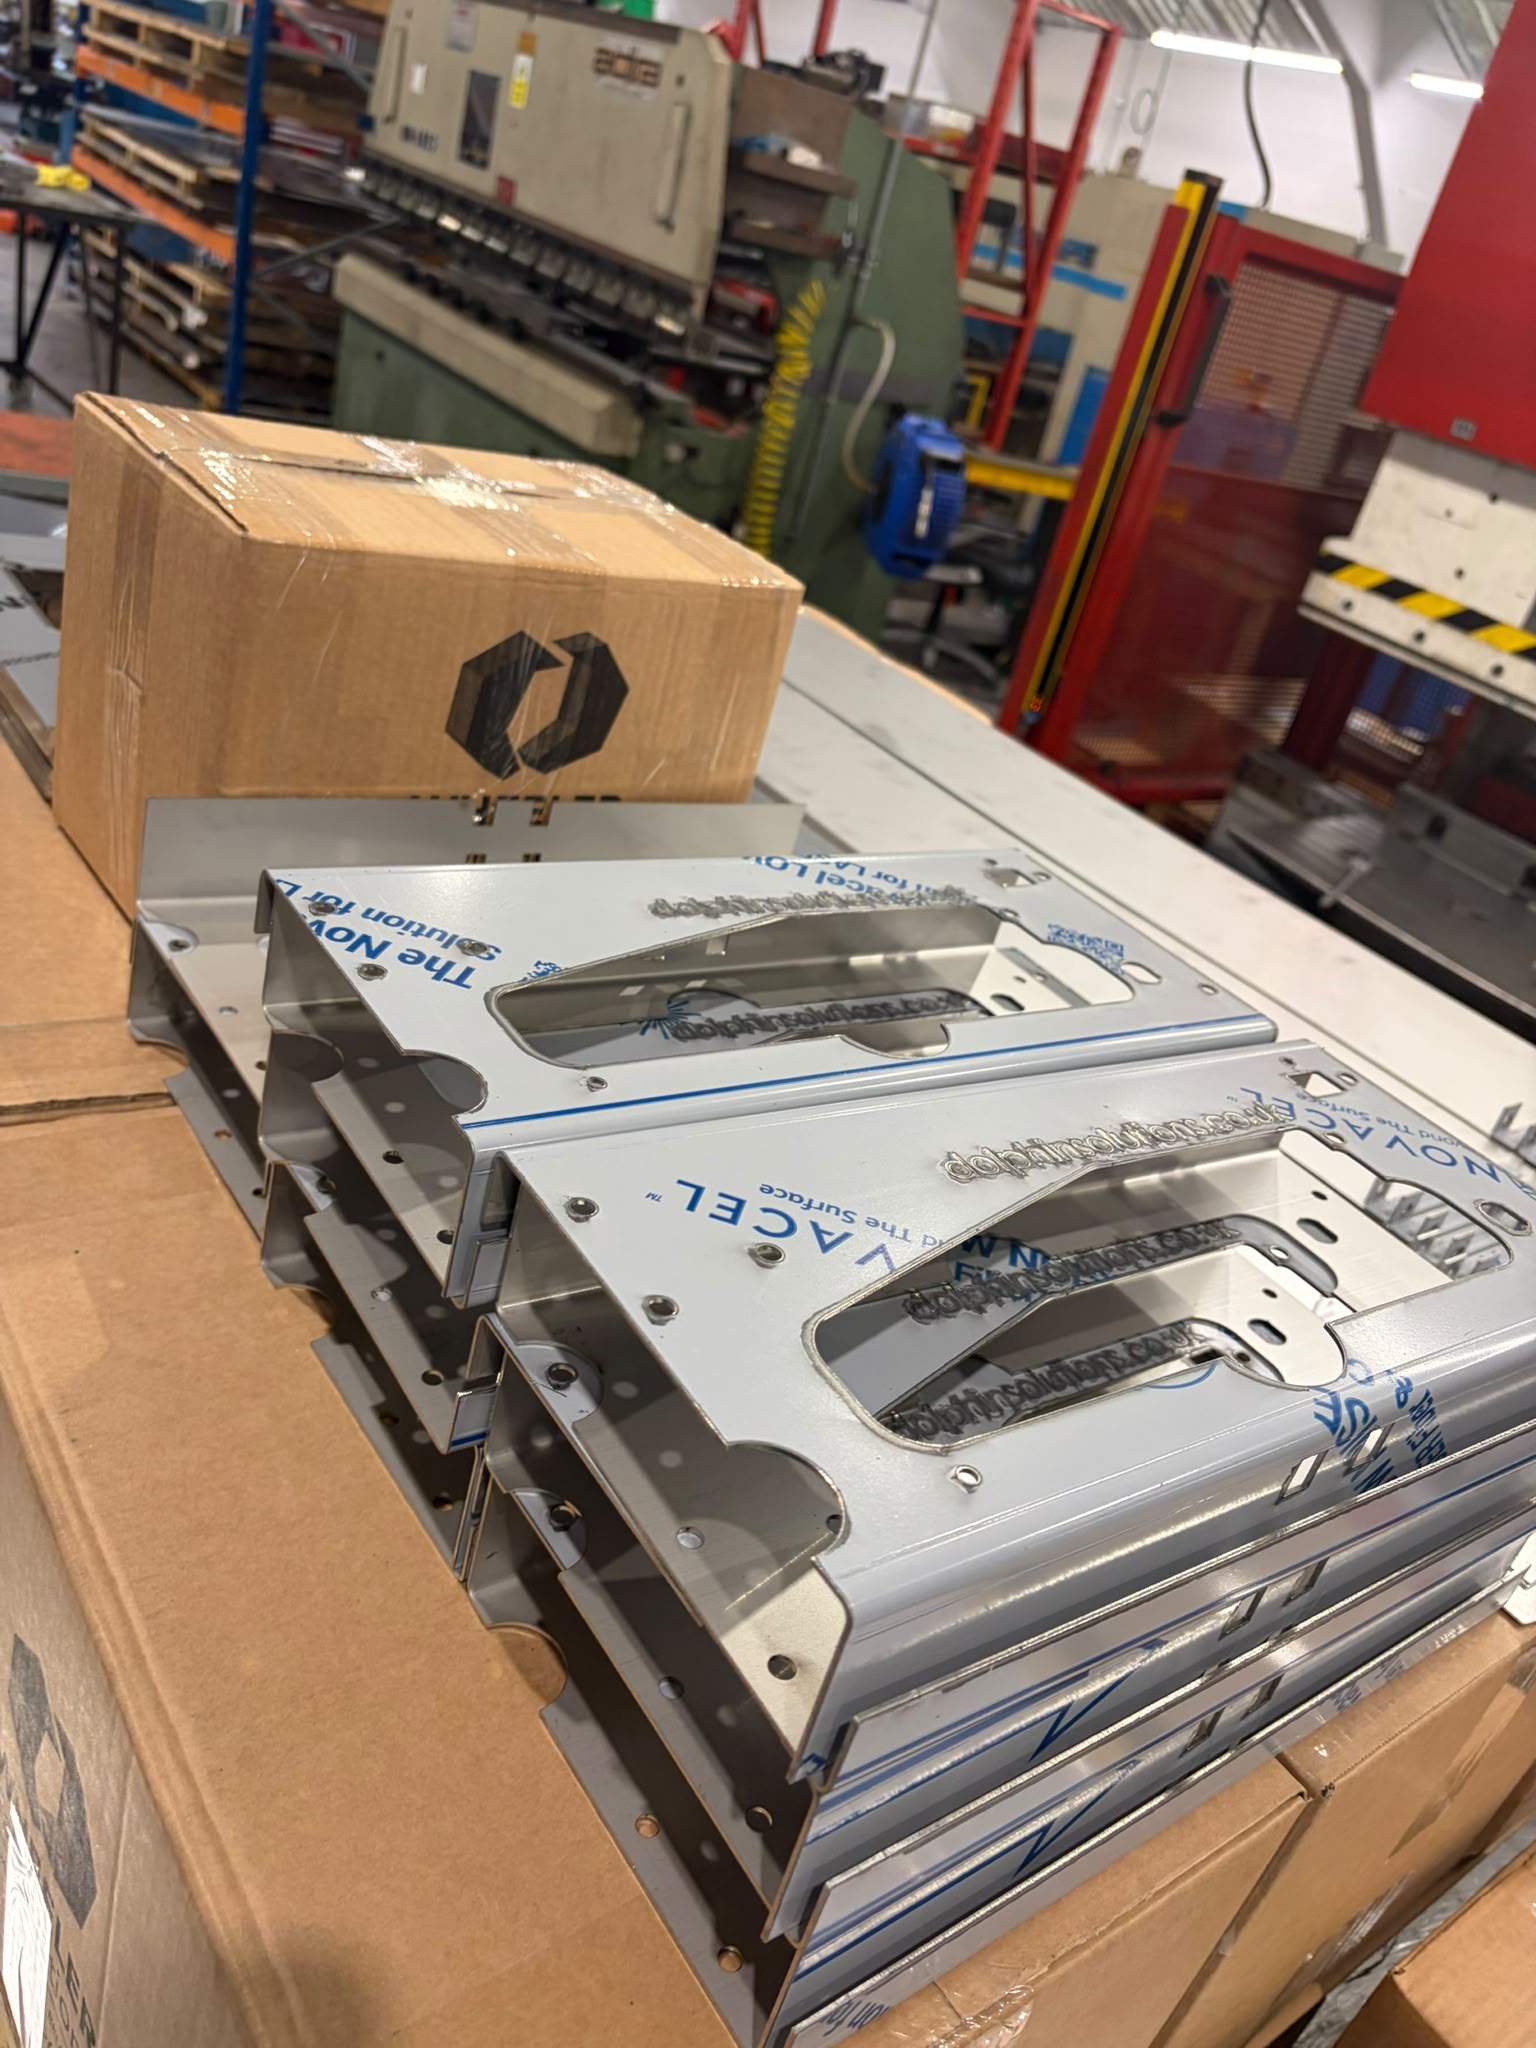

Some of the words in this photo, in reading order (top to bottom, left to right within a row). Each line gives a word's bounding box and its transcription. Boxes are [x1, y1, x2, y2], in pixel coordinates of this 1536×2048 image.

[303, 916, 392, 960] Nov
[361, 908, 502, 962] Slution
[398, 948, 476, 990] The
[758, 1184, 858, 1224] Surface
[865, 1216, 912, 1243] The
